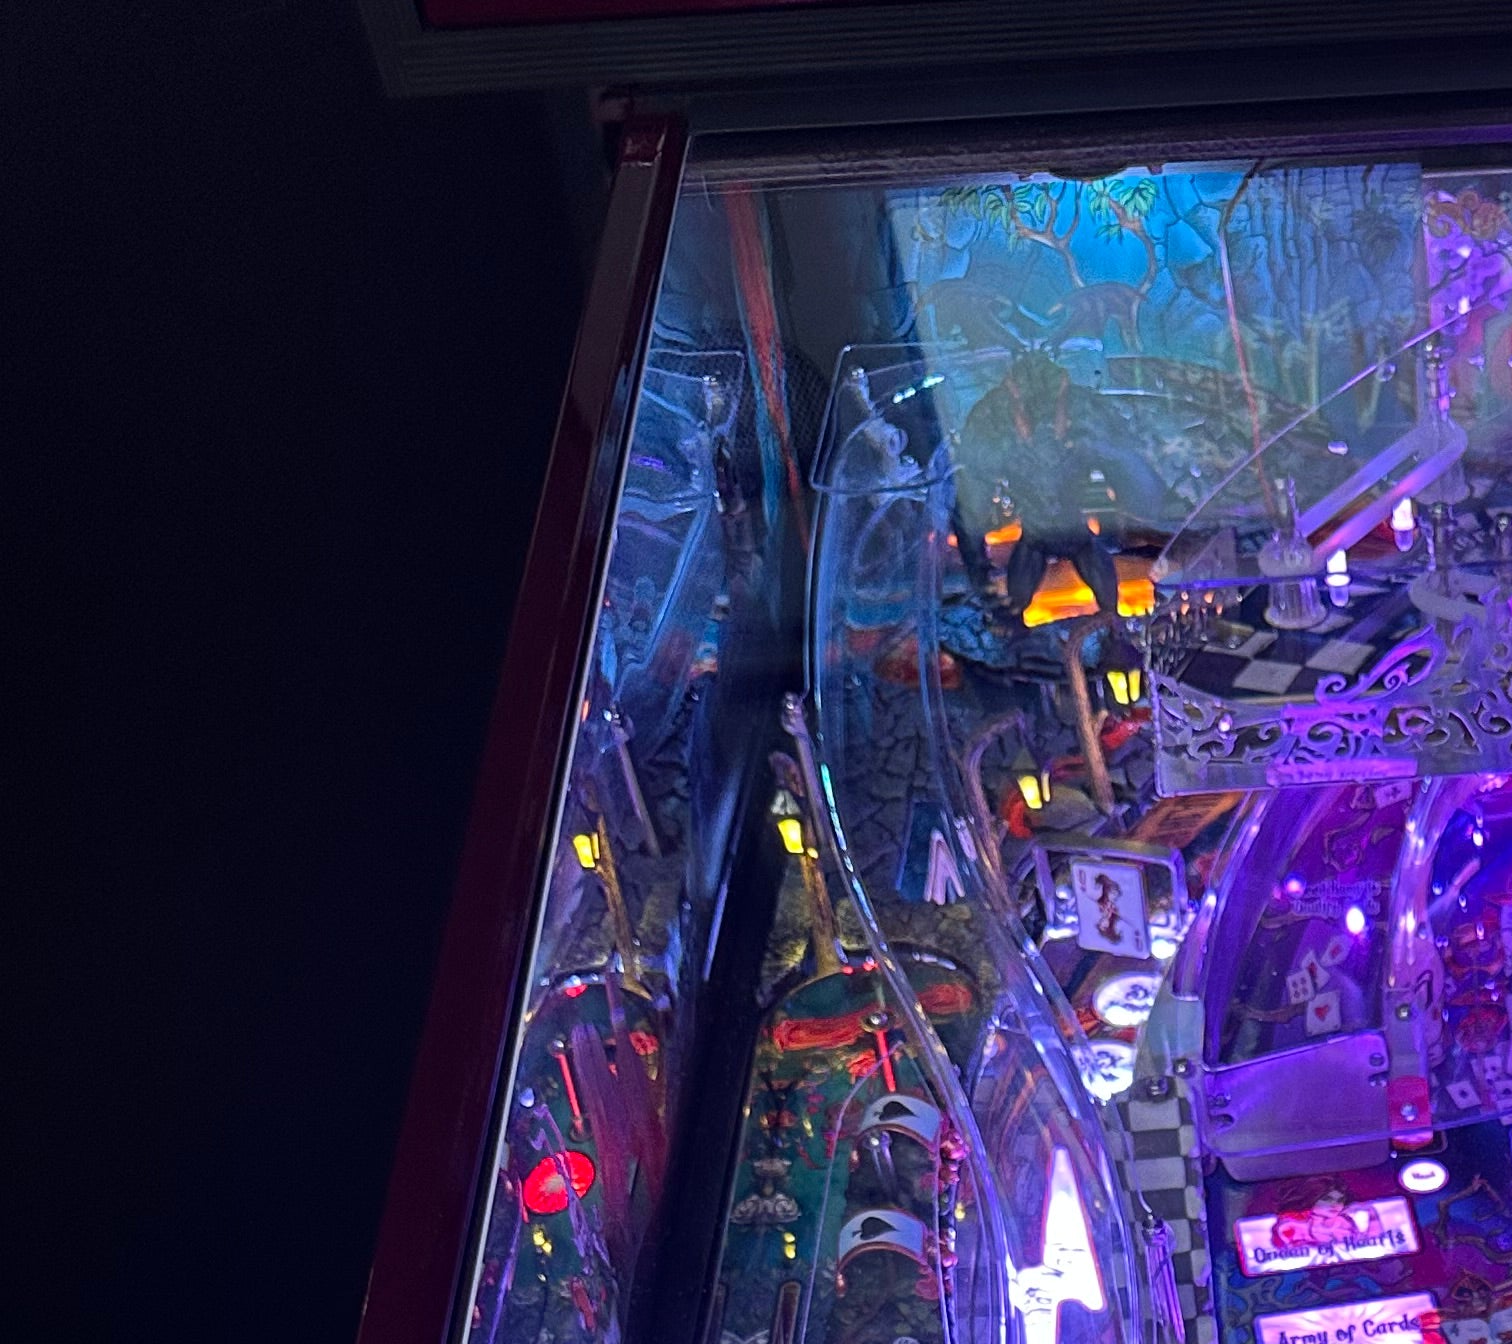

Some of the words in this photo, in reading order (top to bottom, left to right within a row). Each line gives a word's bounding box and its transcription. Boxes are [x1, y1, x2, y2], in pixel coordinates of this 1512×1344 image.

[1317, 1239, 1338, 1257] of
[1343, 1229, 1406, 1251] Hearts
[1336, 1325, 1356, 1344] of
[1363, 1313, 1421, 1337] Cards
